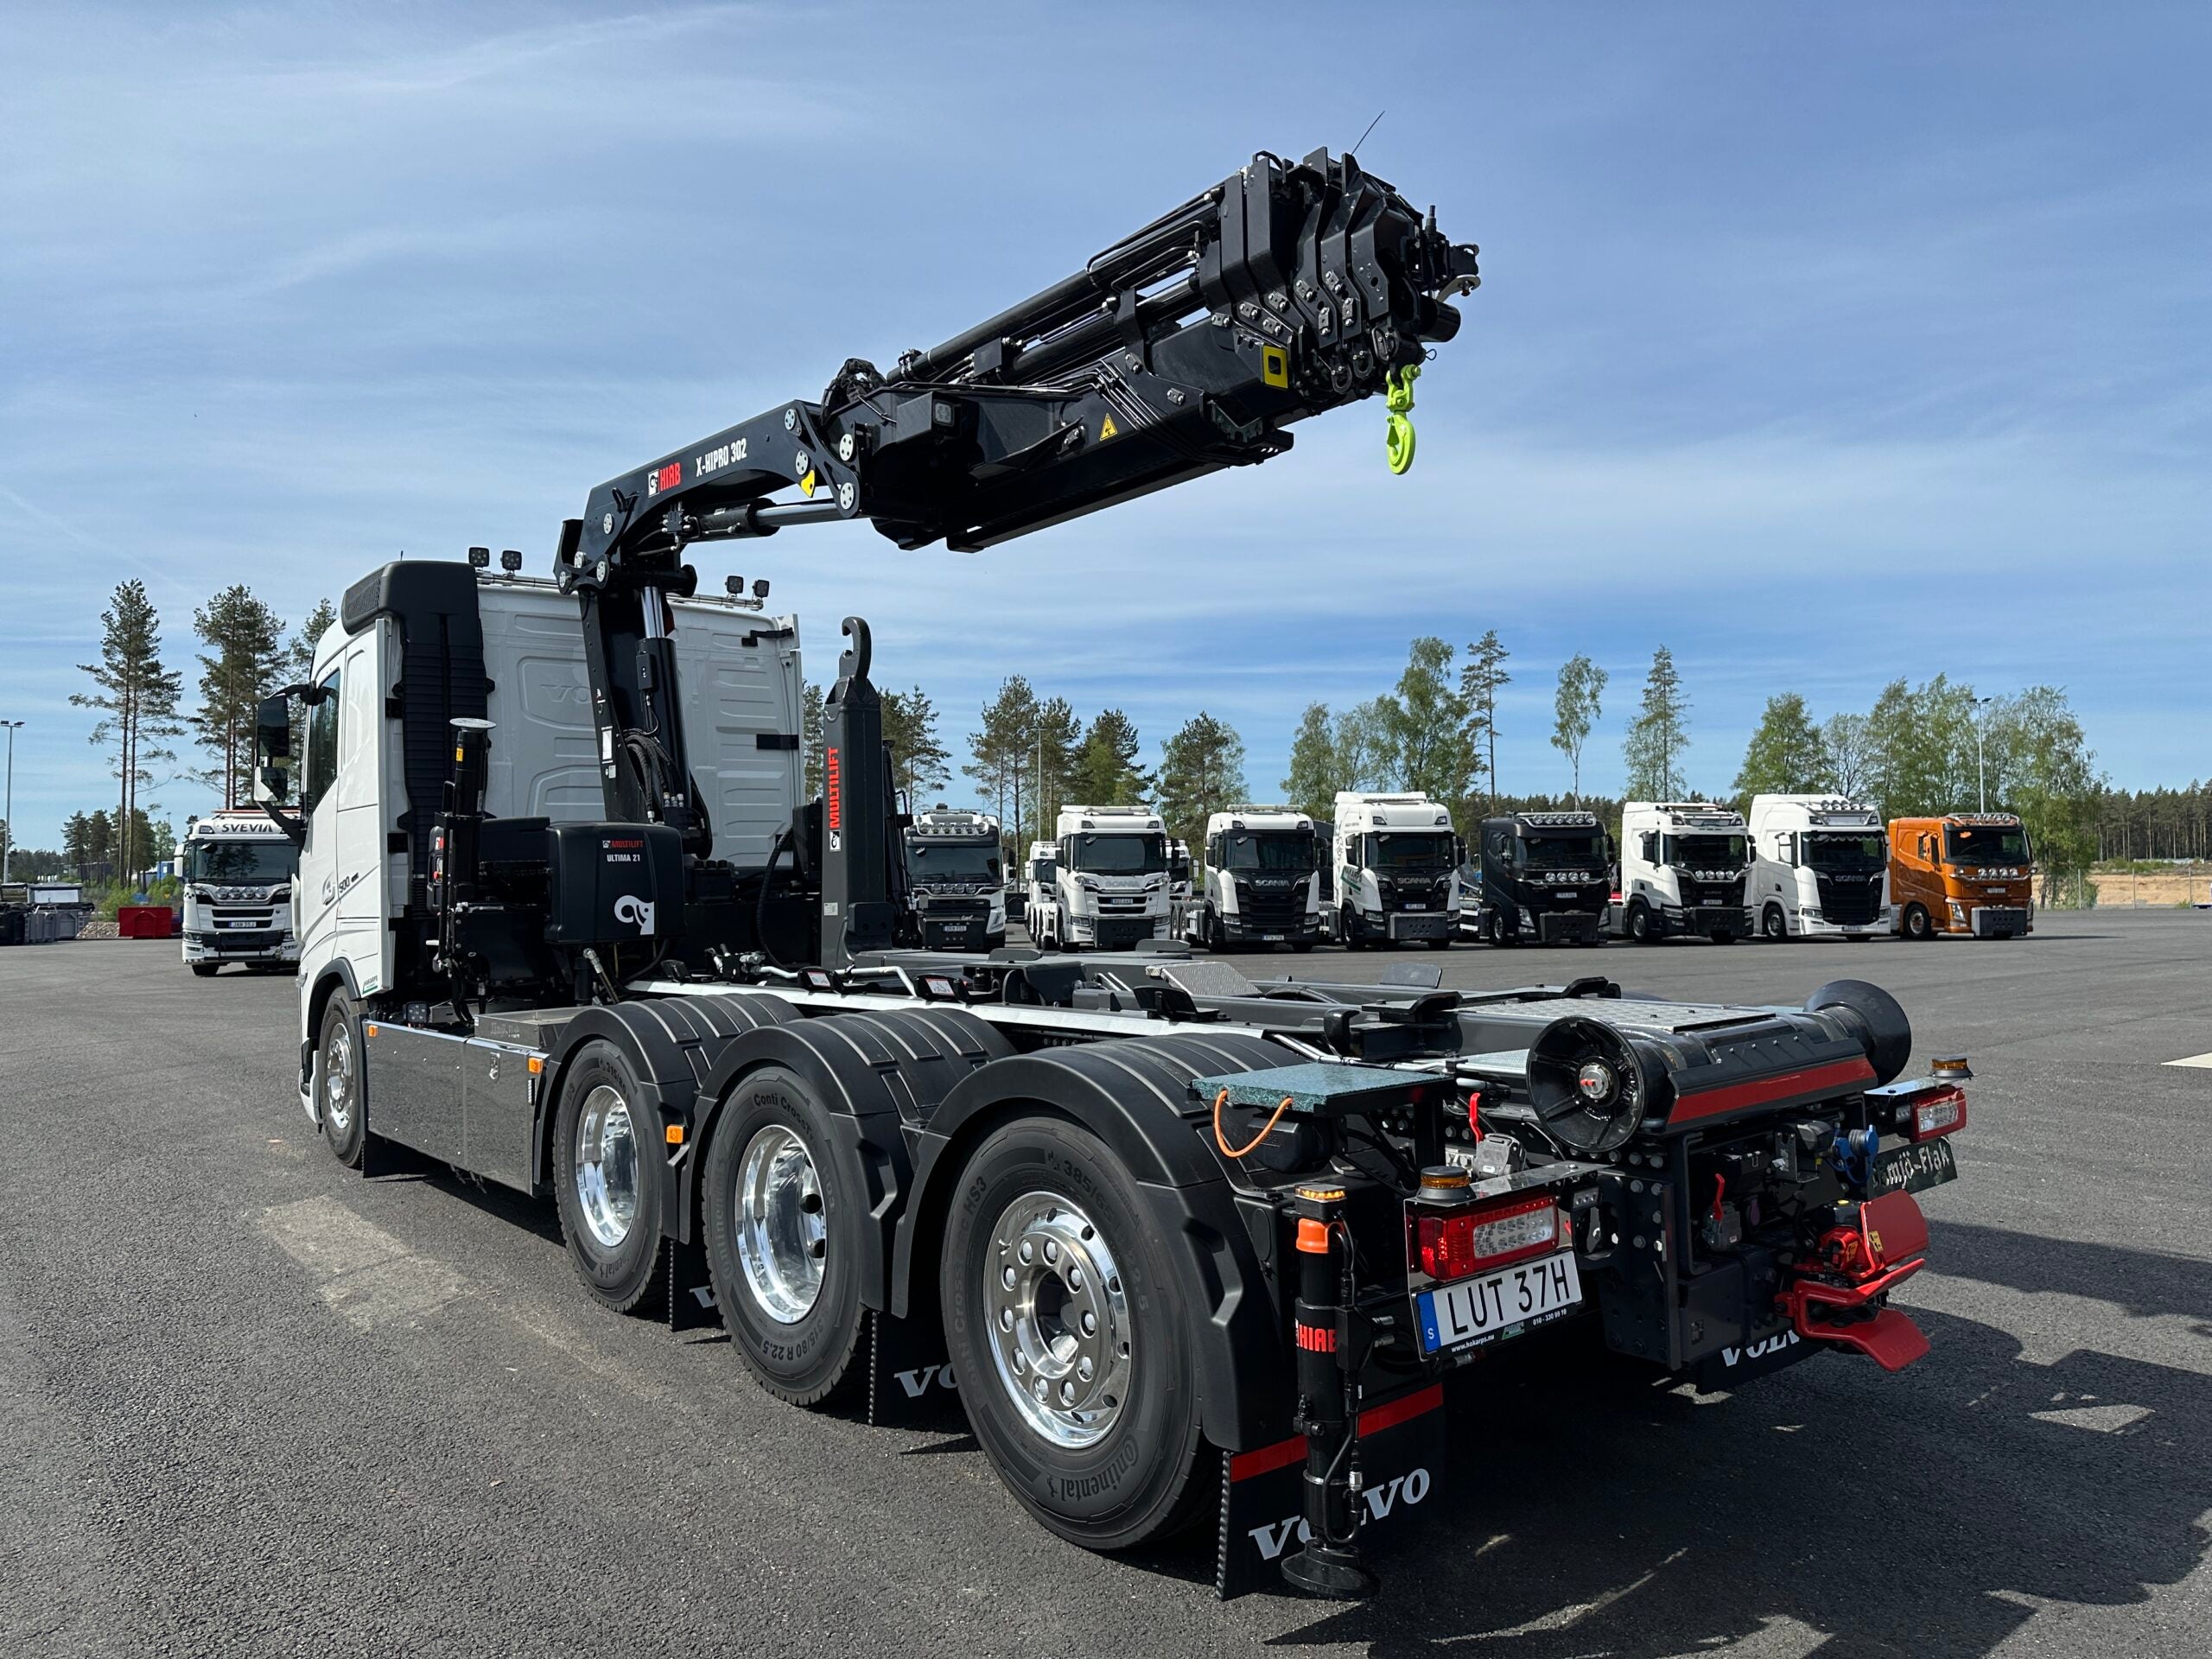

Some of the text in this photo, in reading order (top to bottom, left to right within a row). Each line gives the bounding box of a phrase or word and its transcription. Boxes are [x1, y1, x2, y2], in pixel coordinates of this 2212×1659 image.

[696, 437, 747, 477] X-HIPRO 302
[659, 461, 682, 492] HIAB
[828, 747, 841, 830] MULTILIFT
[221, 823, 273, 833] SVEVIA
[612, 840, 644, 849] MULTILIFT
[607, 854, 640, 862] ULTIMA 21
[753, 1093, 778, 1107] Conti
[963, 1175, 988, 1211] HS3
[1446, 1259, 1570, 1336] LUT 37H
[1427, 1328, 1434, 1339] S
[762, 1340, 785, 1361] 22.5
[786, 1345, 794, 1361] R
[1059, 1434, 1141, 1502] Continental
[1248, 1468, 1431, 1561] VVO
